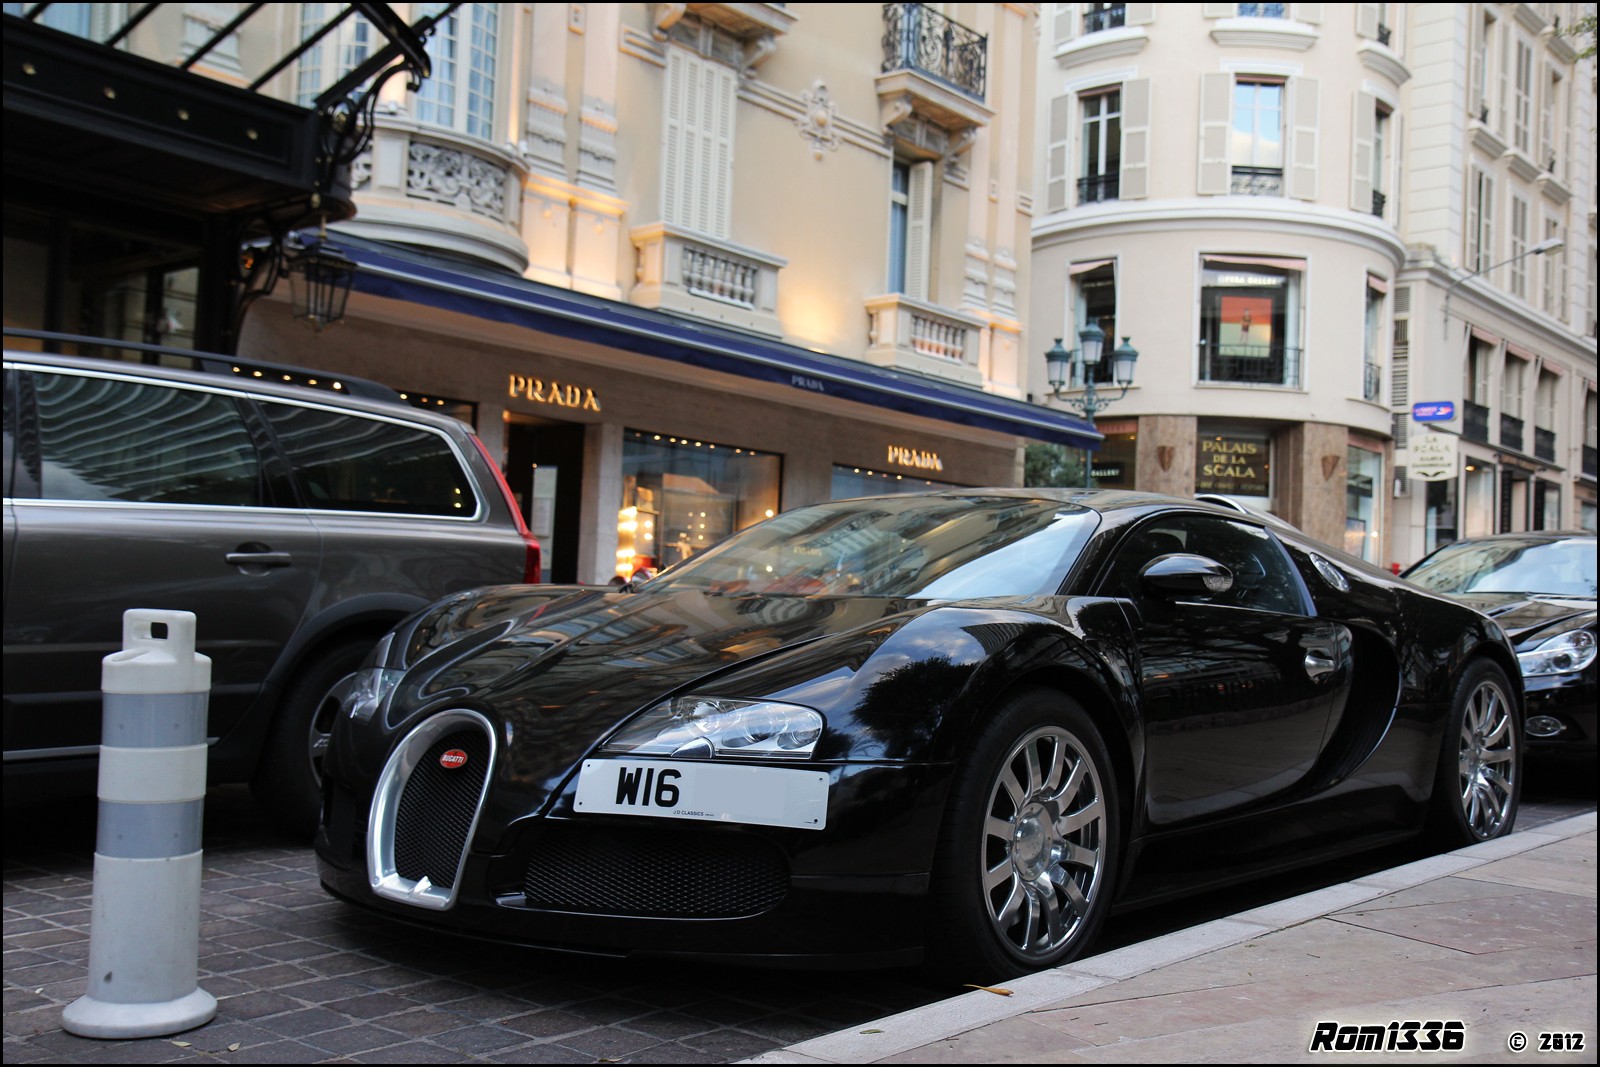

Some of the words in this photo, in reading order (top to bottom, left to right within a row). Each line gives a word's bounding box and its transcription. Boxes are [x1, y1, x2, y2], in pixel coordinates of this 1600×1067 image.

[791, 375, 824, 391] PRADA
[509, 374, 601, 412] PRADA
[1202, 440, 1257, 454] PALAIS
[887, 445, 943, 471] PRADA
[1213, 454, 1228, 464] DE
[1231, 455, 1247, 465] LA
[1203, 464, 1256, 479] SCALA
[442, 755, 465, 763] BUGATTI
[615, 767, 682, 808] W16
